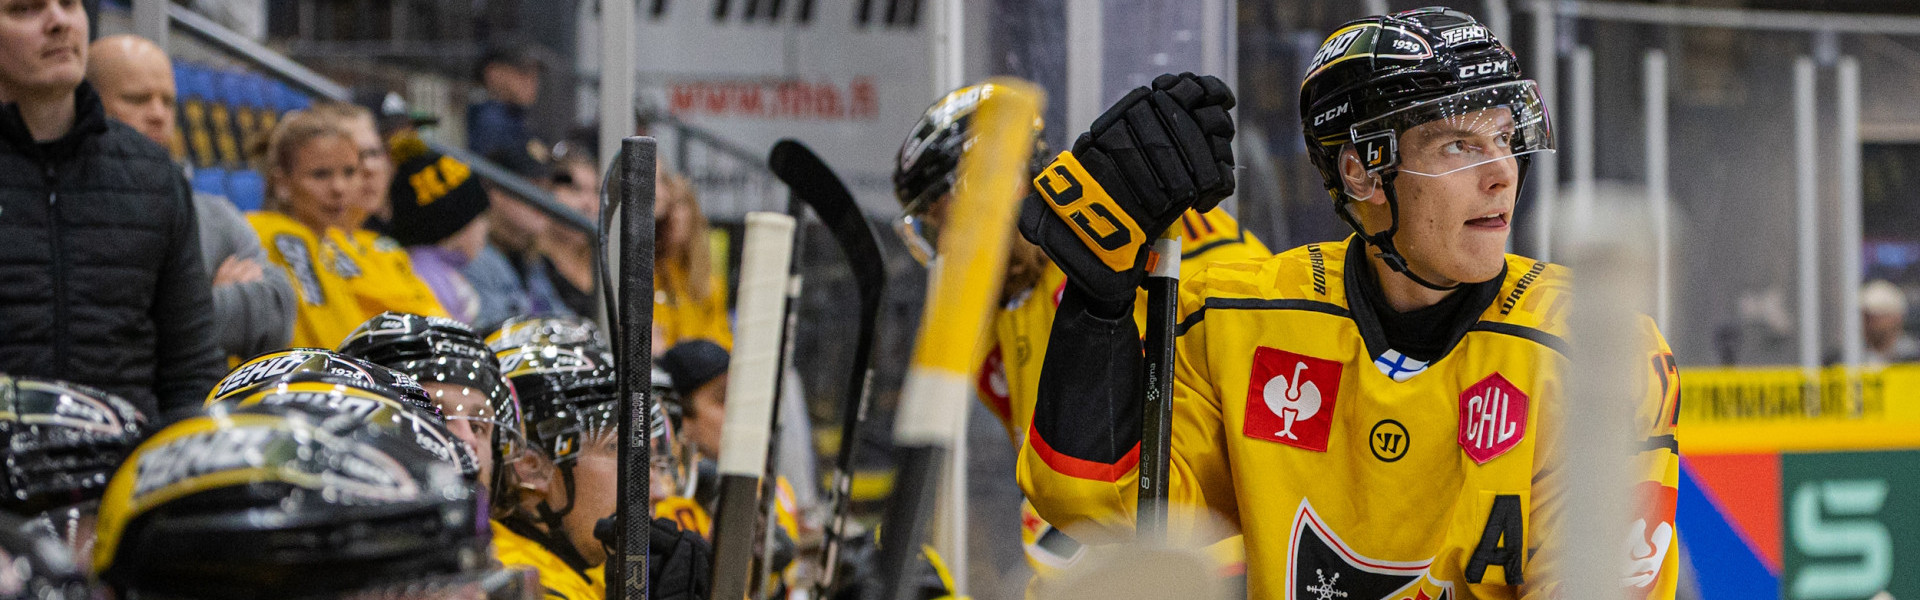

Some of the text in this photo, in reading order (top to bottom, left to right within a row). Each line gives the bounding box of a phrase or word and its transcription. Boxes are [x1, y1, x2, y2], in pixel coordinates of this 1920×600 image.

[1392, 39, 1420, 52] 1929
[1443, 26, 1487, 44] TEHO
[1459, 60, 1508, 78] CCM
[1313, 102, 1349, 127] CCM
[1307, 244, 1326, 296] WARRIOR
[1500, 262, 1546, 316] WARRIO
[214, 355, 310, 398] TEHO
[1149, 362, 1157, 390] sigma
[1467, 387, 1517, 449] CHL
[1141, 476, 1150, 490] 8
[1464, 494, 1524, 586] A
